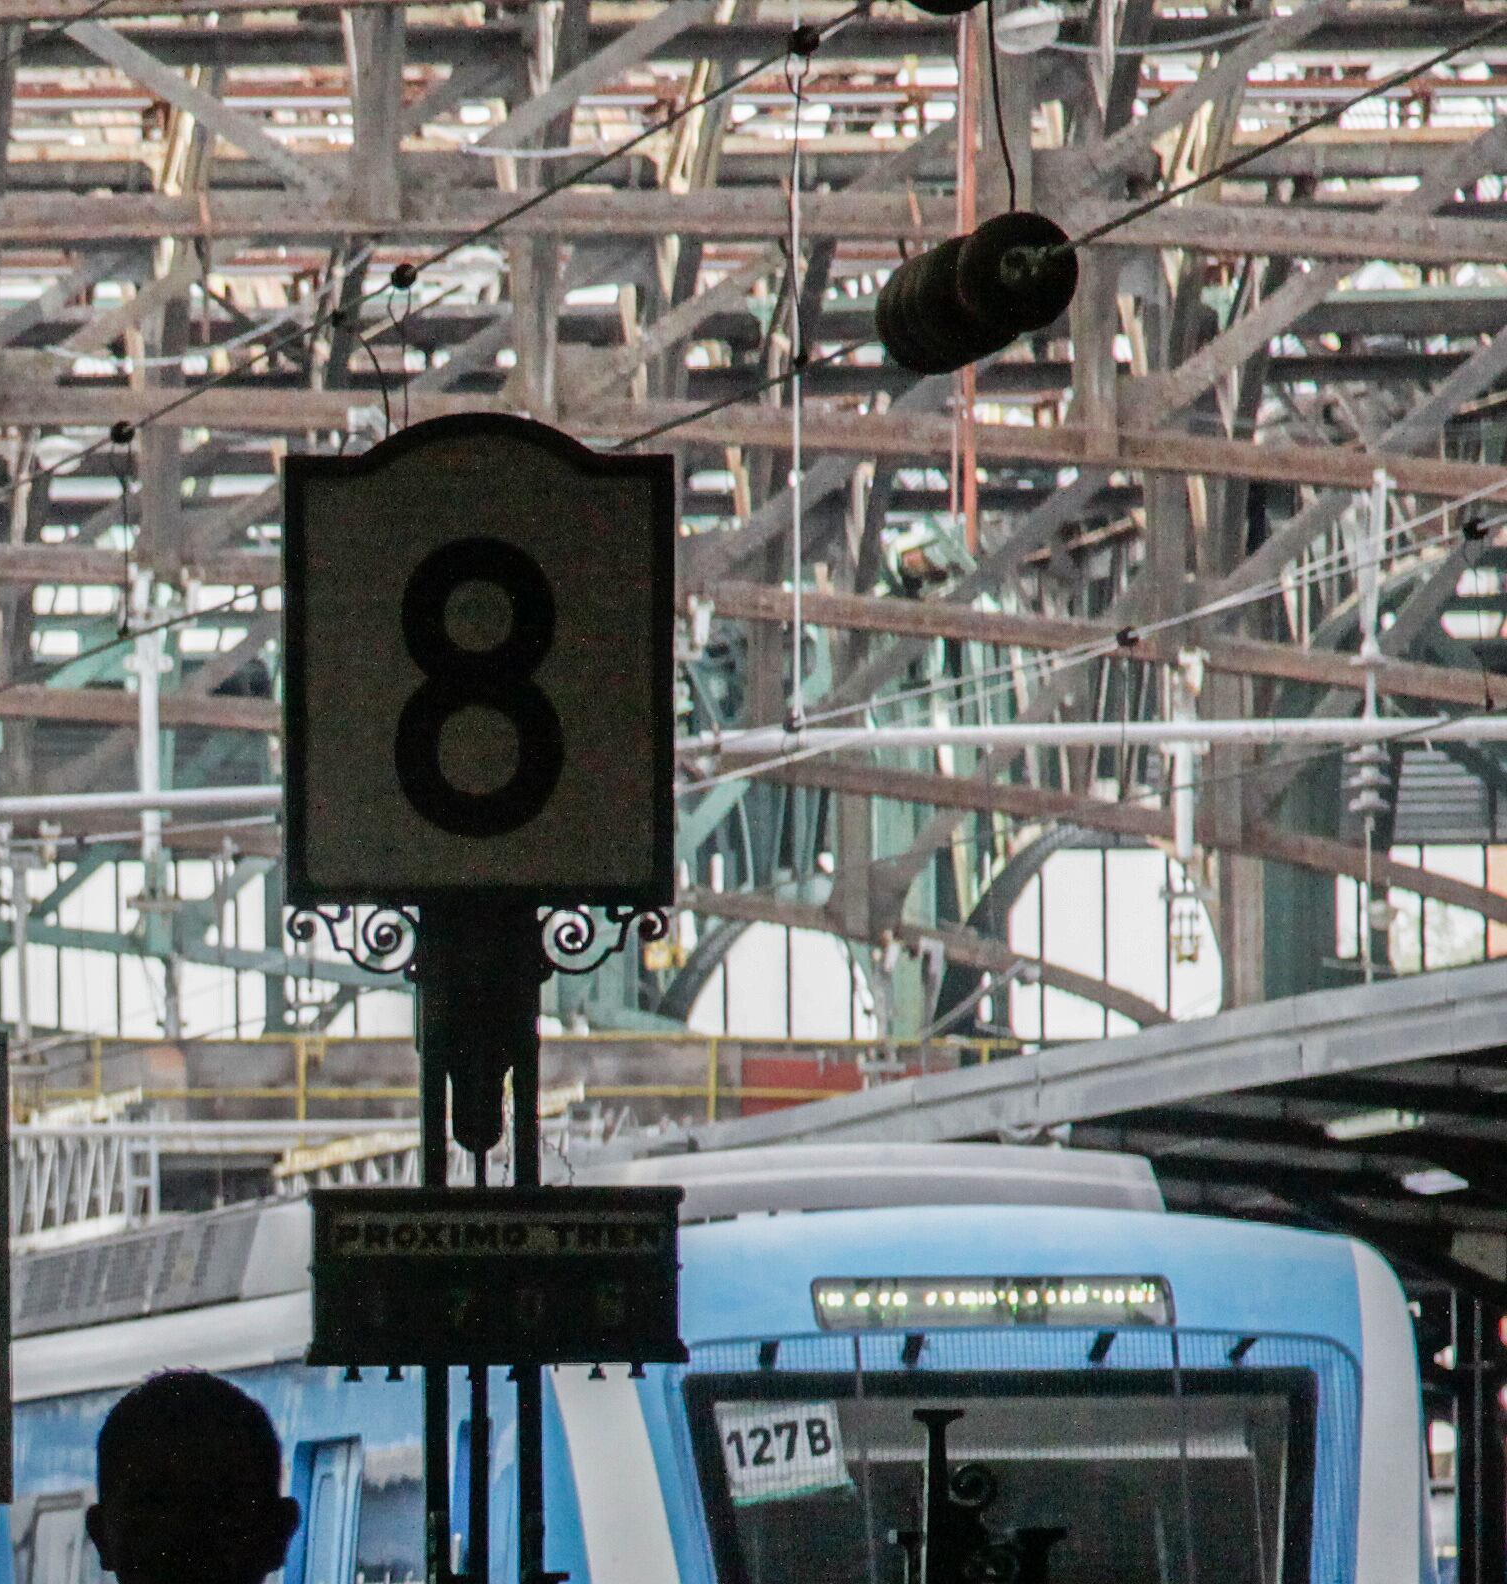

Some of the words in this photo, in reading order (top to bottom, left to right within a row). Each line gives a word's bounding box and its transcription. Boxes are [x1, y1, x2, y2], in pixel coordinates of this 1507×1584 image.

[394, 537, 564, 839] 8
[333, 1221, 528, 1248] PROXIMO
[556, 1220, 661, 1247] TREN
[725, 1415, 833, 1470] 127B
